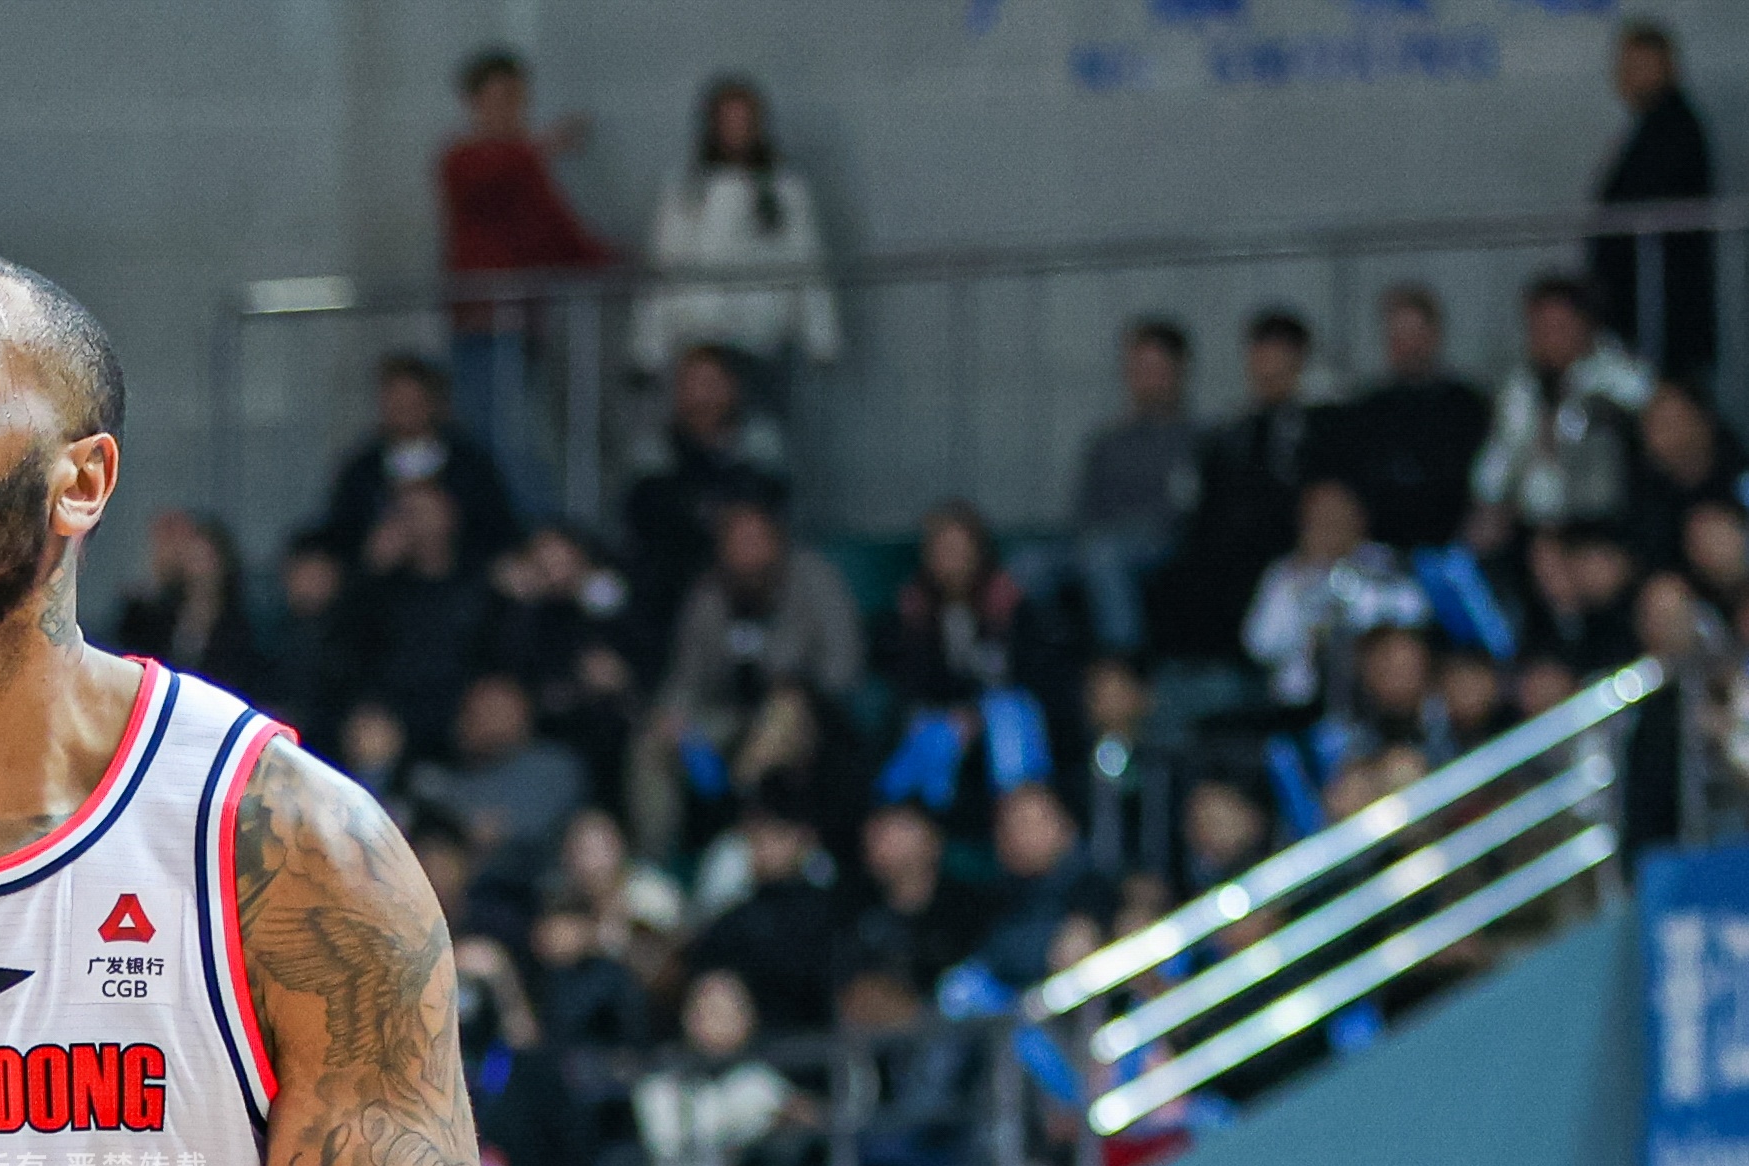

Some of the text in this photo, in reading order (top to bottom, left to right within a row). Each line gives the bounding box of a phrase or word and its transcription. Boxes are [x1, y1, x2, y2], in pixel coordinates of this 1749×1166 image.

[87, 956, 165, 976] 广发银行
[102, 979, 148, 998] CGB
